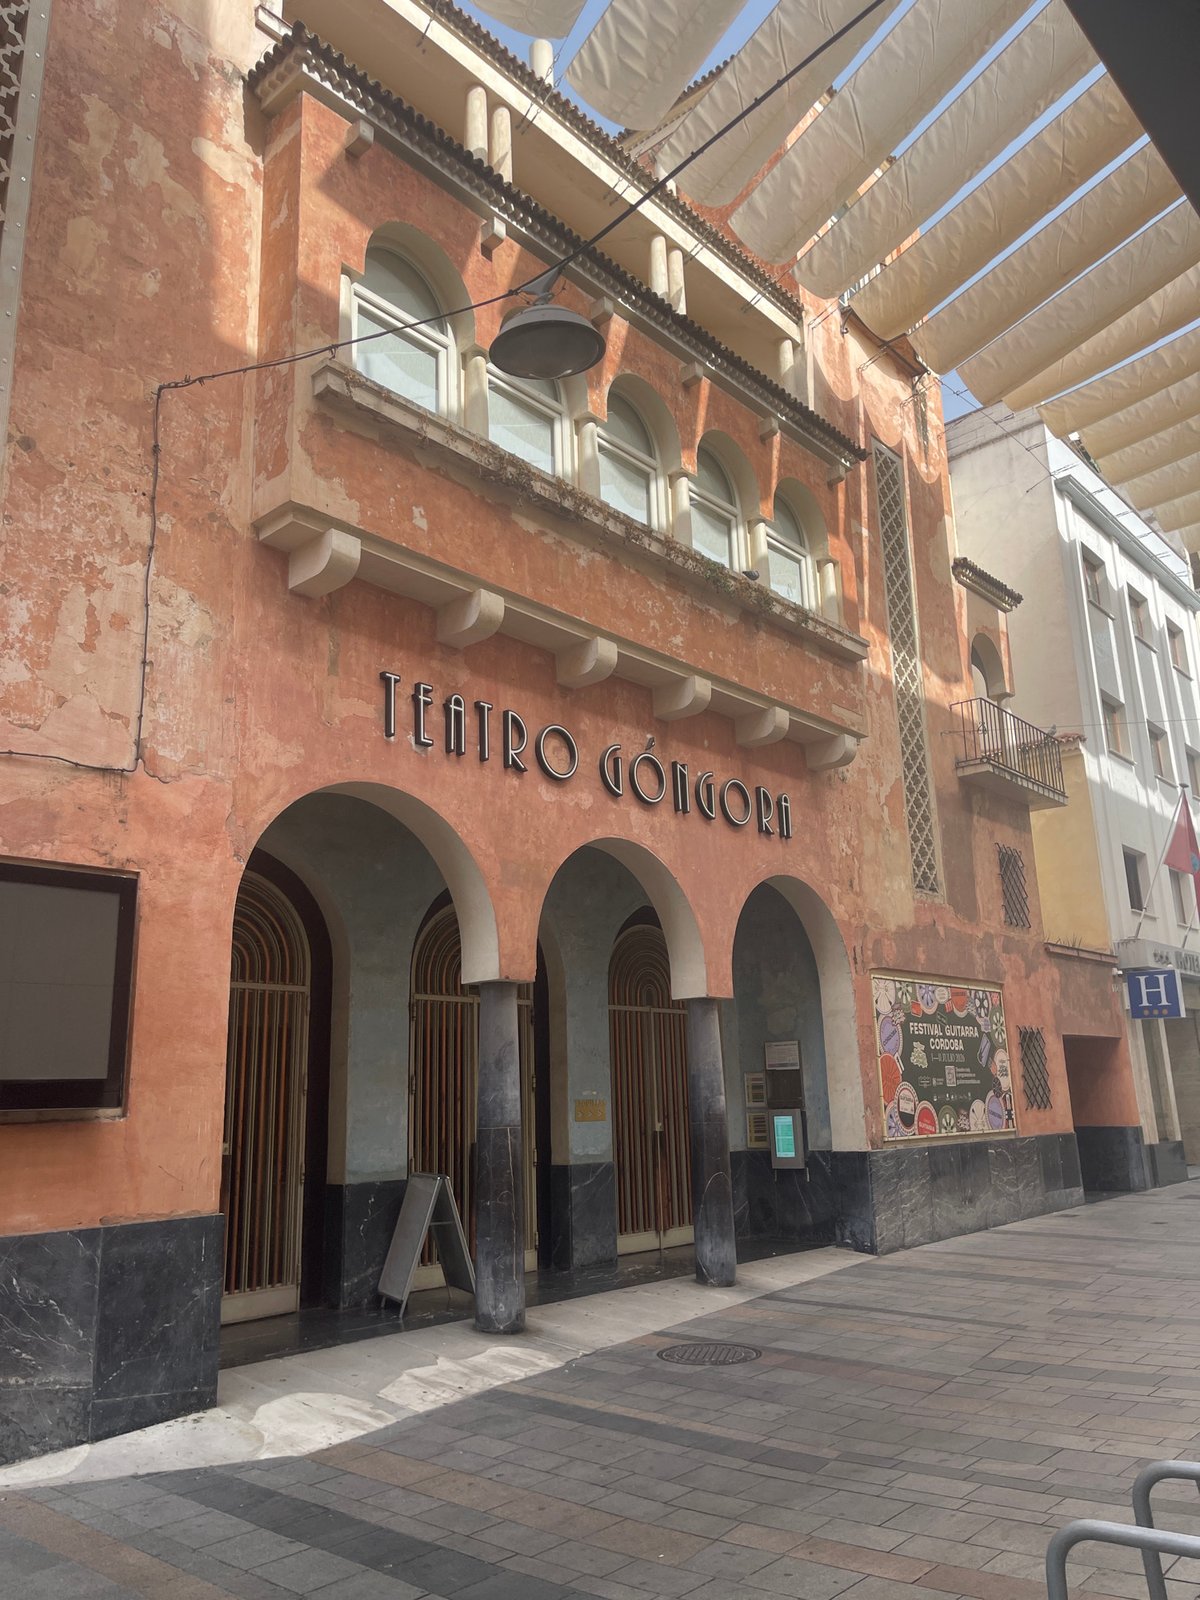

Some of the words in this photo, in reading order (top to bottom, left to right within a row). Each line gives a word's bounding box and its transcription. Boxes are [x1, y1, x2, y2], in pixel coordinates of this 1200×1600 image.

[380, 671, 579, 781] TEATRO
[600, 737, 792, 840] GÓNGORA
[1135, 974, 1172, 1007] H
[909, 1022, 943, 1036] FESTIVAL
[945, 1024, 979, 1038] GUITARRA
